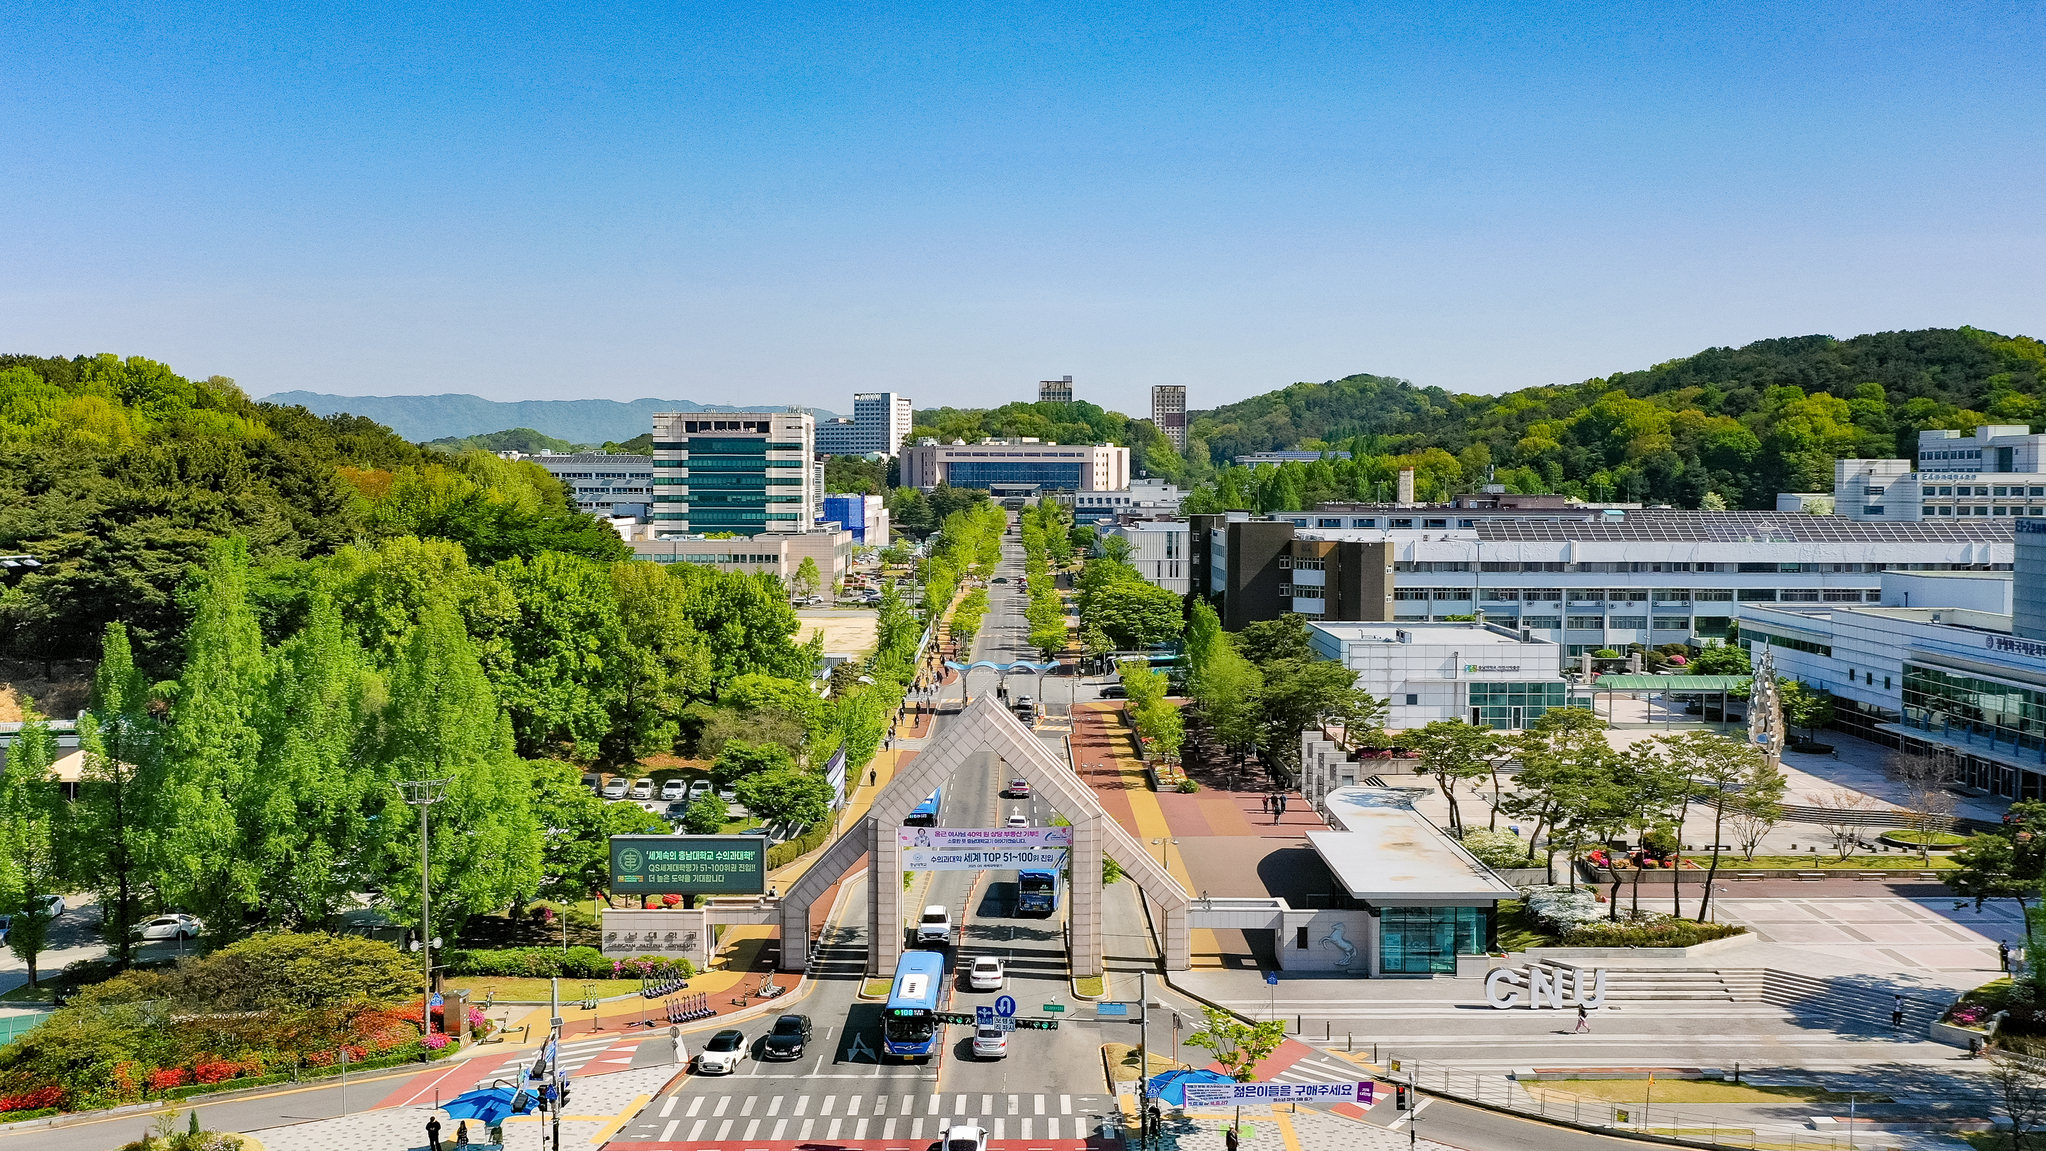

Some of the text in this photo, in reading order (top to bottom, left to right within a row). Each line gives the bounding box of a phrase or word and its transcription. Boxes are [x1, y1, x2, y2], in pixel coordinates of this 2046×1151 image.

[678, 851, 714, 860] 충남대학교
[964, 853, 981, 862] 세계
[983, 853, 1001, 862] TOP
[739, 864, 756, 872] 진입!!
[1485, 967, 1606, 1009] CNU
[1234, 1084, 1292, 1098] 젊은이들을
[1294, 1084, 1352, 1096] 구해주세요
